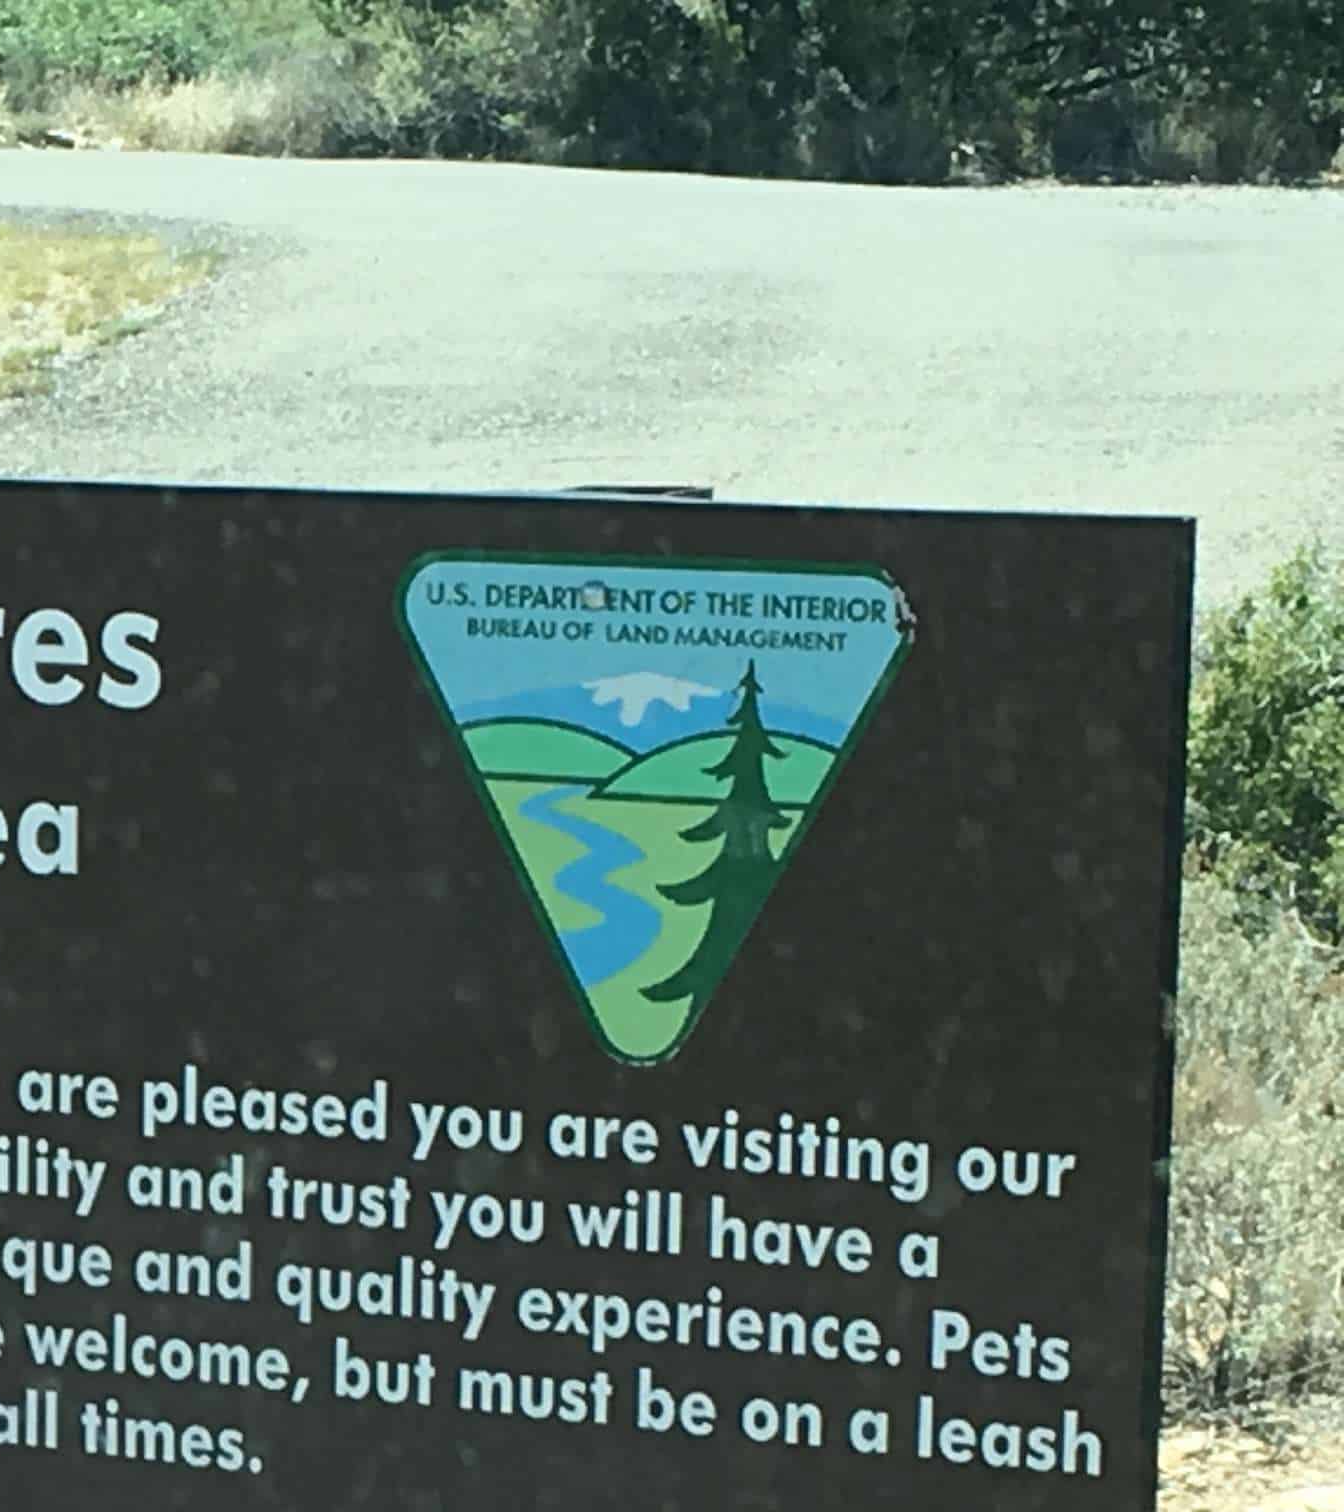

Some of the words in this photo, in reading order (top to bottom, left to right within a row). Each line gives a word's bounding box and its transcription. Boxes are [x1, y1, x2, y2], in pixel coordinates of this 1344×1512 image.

[426, 583, 476, 606] U.S.
[661, 590, 695, 615] OF
[707, 593, 754, 618] THE
[763, 595, 886, 623] INTERIOR
[467, 618, 556, 639] BUREAU
[564, 622, 594, 641] OF
[605, 623, 668, 646] LAND
[675, 626, 847, 652] MANAGEMENT
[18, 1069, 120, 1119] are
[143, 1063, 388, 1142] pleased
[409, 1102, 524, 1161] you
[549, 1113, 660, 1165] are
[682, 1108, 930, 1203] visiting
[957, 1146, 1077, 1198] our
[127, 1153, 245, 1215] and
[267, 1165, 412, 1230] trust
[429, 1191, 545, 1251] you
[567, 1189, 683, 1256] will
[709, 1194, 873, 1273] have
[898, 1232, 939, 1279] a
[135, 1239, 253, 1302] and
[276, 1255, 497, 1342] quality
[518, 1285, 902, 1367] experience.
[931, 1308, 1070, 1382] Pets
[26, 1314, 310, 1403] welcome,
[335, 1335, 437, 1406] but
[459, 1368, 614, 1425] must
[637, 1366, 718, 1436] be
[741, 1397, 823, 1447] on
[849, 1408, 889, 1454] a
[917, 1394, 1102, 1477] leash
[80, 1397, 263, 1475] times.
